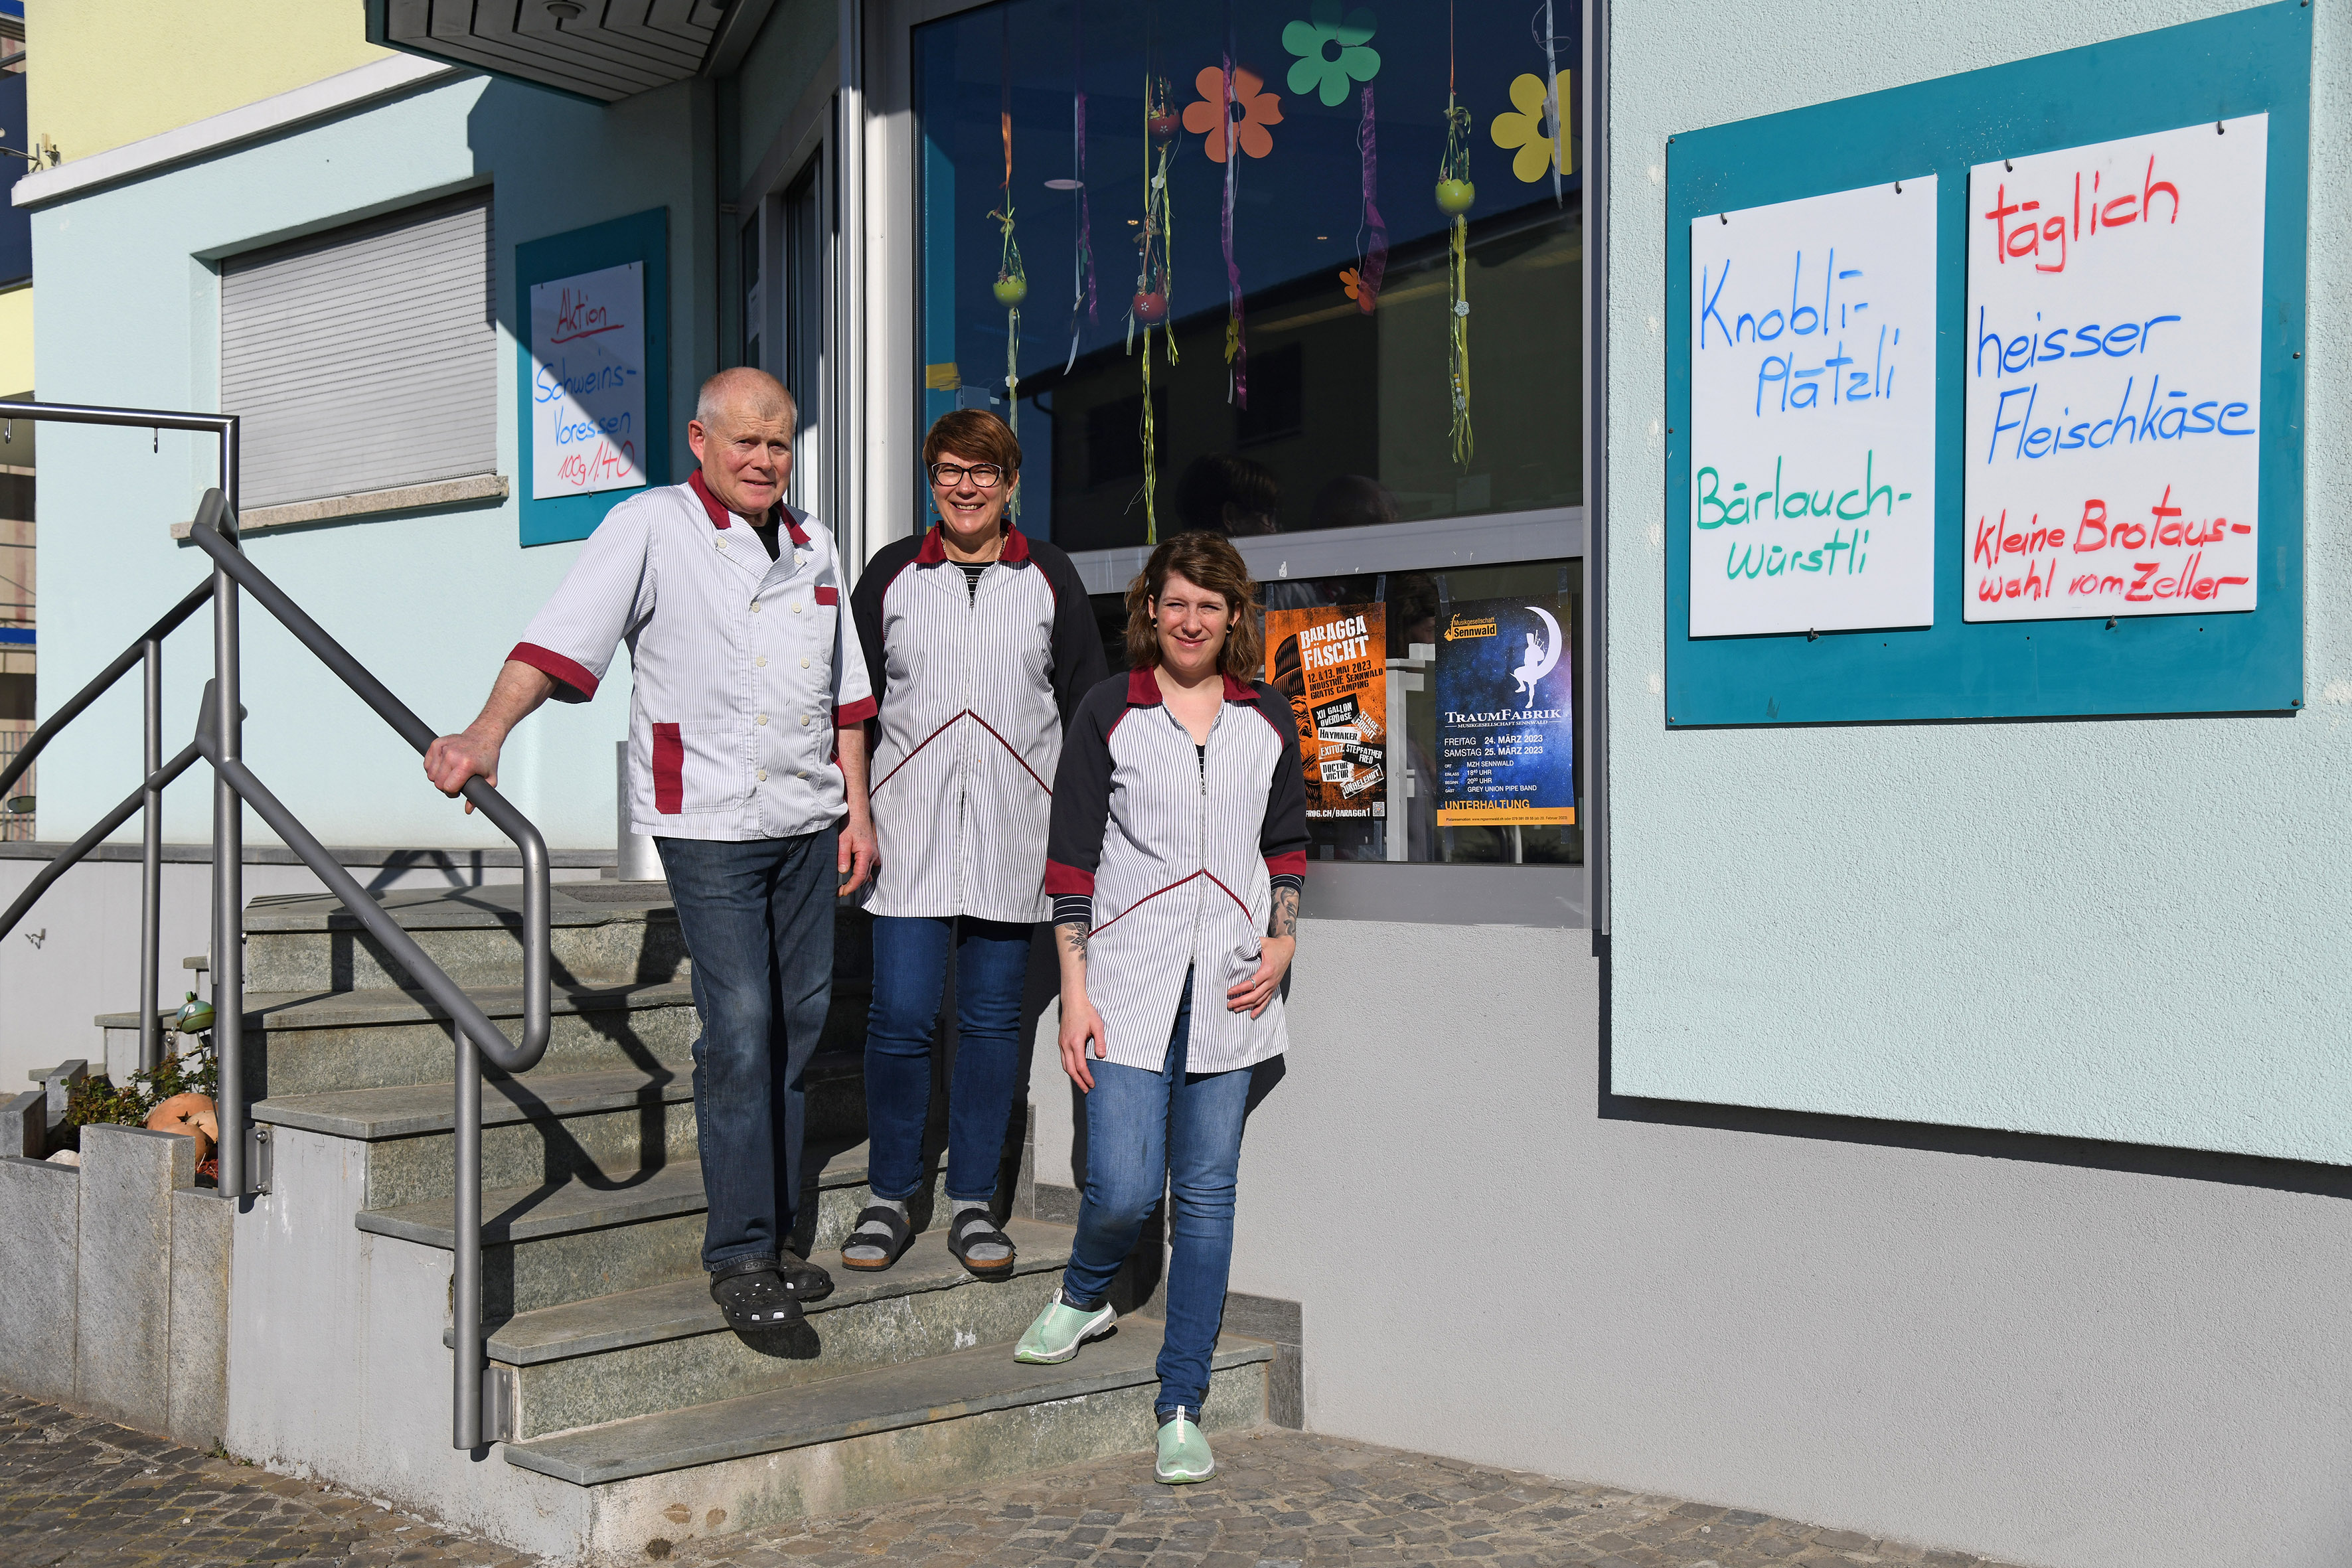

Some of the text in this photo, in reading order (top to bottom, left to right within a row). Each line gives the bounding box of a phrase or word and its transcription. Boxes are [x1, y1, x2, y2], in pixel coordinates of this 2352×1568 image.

[1986, 152, 2180, 274] täglich
[1701, 248, 1869, 350] Knobli-
[556, 287, 607, 335] Aktion
[1978, 305, 2181, 378] heisser
[535, 347, 637, 403] Schweins-
[554, 406, 631, 446] Voressen
[1988, 374, 2255, 464] Fleischkäse
[558, 454, 586, 486] 100g
[1697, 449, 1912, 530] Bärlauch-
[2073, 483, 2251, 554] Brotaus-
[1978, 558, 2056, 602] wahl
[2068, 573, 2124, 595] vom
[1300, 615, 1367, 649] BARAGGA
[1454, 617, 1494, 627] Musikgesellschaft
[1454, 625, 1495, 637] Sennwald
[1302, 635, 1369, 670] FÄSCHT
[1308, 673, 1318, 683] 12.
[1324, 669, 1335, 680] 13.
[1336, 665, 1350, 675] MAI
[1352, 660, 1371, 672] 2023
[1310, 668, 1383, 691] INDUSTRIE SENNWALD
[1310, 680, 1369, 700] GRATIS CAMPING
[1316, 702, 1352, 720] XII GALLON
[1359, 710, 1379, 731] STAGE
[1320, 729, 1358, 741] HAYMAKER
[1354, 717, 1376, 740] FRIGHT
[1444, 737, 1476, 746] FREITAG
[1498, 734, 1522, 744] MÄRZ
[1346, 744, 1383, 759] STEPFATHER
[1359, 754, 1373, 765] FRED
[1444, 748, 1482, 757] SAMSTAG
[1498, 745, 1522, 755] MÄRZ
[1323, 762, 1348, 773] DOCTOR
[1326, 769, 1349, 781] VICTOR
[1445, 799, 1529, 810] UNTERHALTUNG
